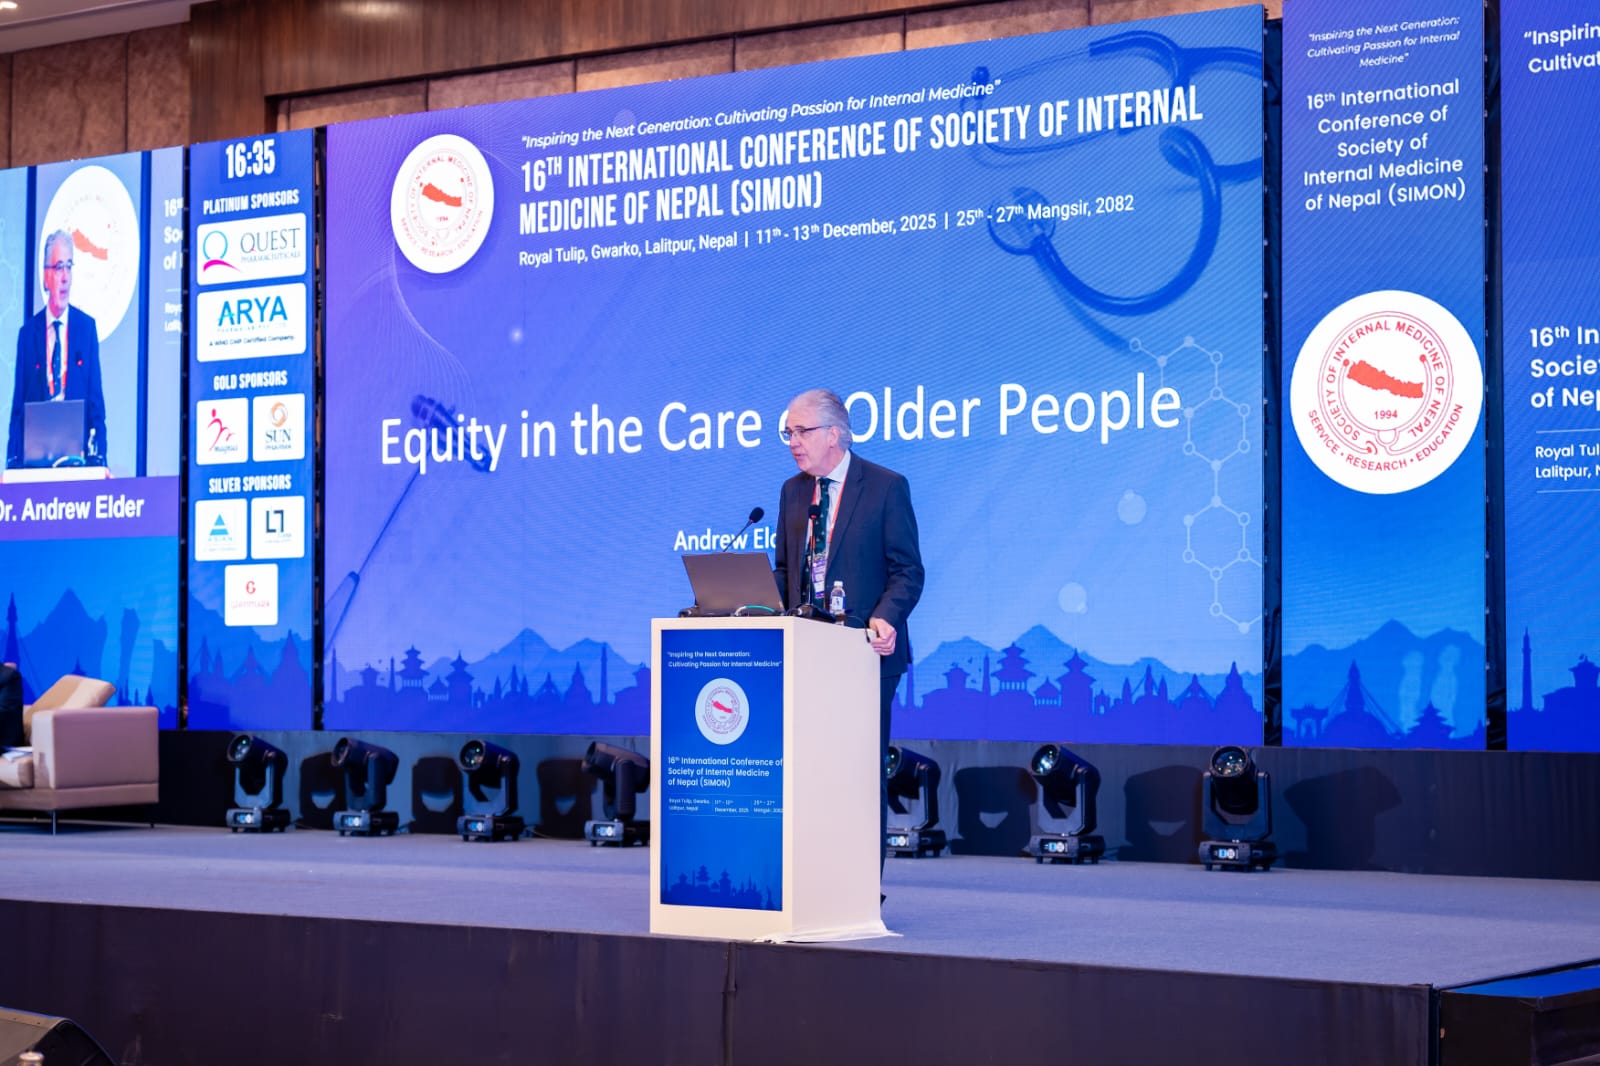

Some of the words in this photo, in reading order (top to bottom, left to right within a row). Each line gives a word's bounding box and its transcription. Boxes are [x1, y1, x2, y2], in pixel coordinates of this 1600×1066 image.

[1356, 25, 1373, 36] the
[1374, 22, 1399, 35] Next
[1400, 16, 1461, 32] Generation:
[1307, 43, 1361, 58] Cultivating
[1362, 39, 1401, 52] Passion
[1403, 36, 1418, 47] for
[1419, 31, 1461, 45] Internal
[1307, 92, 1336, 110] 16th
[1341, 78, 1460, 107] International
[582, 128, 603, 141] the
[606, 123, 635, 139] Next
[638, 116, 712, 135] Generation:
[715, 108, 787, 126] Cultivating
[791, 100, 843, 117] Passion
[847, 96, 867, 111] for
[869, 87, 925, 108] Internal
[1318, 109, 1424, 134] Conference
[1430, 105, 1448, 122] of
[521, 156, 562, 192] 16TH
[568, 139, 733, 188] INTERNATIONAL
[739, 121, 886, 170] CONFERENCE
[894, 117, 923, 153] OF
[930, 104, 1031, 150] SOCIETY
[1039, 100, 1069, 138] OF
[1078, 85, 1203, 133] INTERNAL
[1337, 136, 1404, 157] Society
[1410, 133, 1428, 150] of
[225, 139, 276, 179] 16:35
[1304, 164, 1373, 186] Internal
[1379, 157, 1464, 180] Medicine
[203, 195, 249, 215] PLATINUM
[250, 189, 300, 209] SPONSORS
[520, 193, 617, 235] MEDICINE
[623, 190, 649, 225] OF
[656, 183, 723, 222] NEPAL
[731, 171, 822, 216] (SIMON)
[1305, 194, 1323, 211] of
[1328, 189, 1381, 212] Nepal
[1388, 176, 1466, 207] (SIMON)
[240, 228, 301, 254] QUEST
[519, 248, 552, 268] Royal
[555, 246, 588, 263] Tulip,
[591, 242, 642, 260] Gwarko,
[645, 237, 696, 256] Lalitpur,
[699, 231, 737, 252] Nepal
[823, 216, 897, 239] December,
[900, 213, 937, 233] 2025
[1027, 200, 1092, 222] Mangsir,
[1095, 195, 1134, 214] 2082
[163, 251, 177, 270] of
[218, 296, 288, 327] ARYA
[1333, 320, 1391, 362] INTERNAL
[1395, 320, 1444, 371] MEDICINE
[1530, 325, 1570, 348] 16th
[1326, 366, 1337, 384] OF
[1530, 354, 1600, 378] Socie
[213, 374, 237, 391] GOLD
[239, 370, 288, 389] SPONSORS
[1435, 376, 1446, 395] OF
[1530, 386, 1554, 408] of
[381, 414, 508, 475] Equity
[521, 409, 556, 458] in
[570, 403, 643, 456] the
[659, 401, 762, 452] Care
[844, 384, 981, 443] Older
[1000, 372, 1182, 445] People
[1326, 389, 1361, 441] SOCIETY
[1373, 410, 1399, 420] 1994
[1408, 399, 1441, 438] NEPAL
[265, 428, 292, 443] SUN
[1308, 409, 1340, 455] SERVICE
[1345, 453, 1408, 472] RESEARCH
[1415, 403, 1464, 462] EDUCATION
[1535, 444, 1574, 461] Royal
[209, 477, 241, 494] SILVER
[243, 474, 292, 492] SPONSORS
[1535, 465, 1592, 481] Lalitpur,
[21, 497, 91, 521] Andrew
[95, 494, 145, 518] Elder
[673, 528, 748, 551] Andrew
[668, 767, 694, 777] Society
[696, 767, 704, 775] of
[705, 768, 734, 776] Internal
[735, 768, 770, 777] Medicine
[681, 757, 728, 765] International
[730, 758, 774, 766] Conference
[775, 758, 783, 766] of
[668, 778, 675, 786] of
[677, 778, 698, 787] Nepal
[700, 777, 731, 788] (SIMON)
